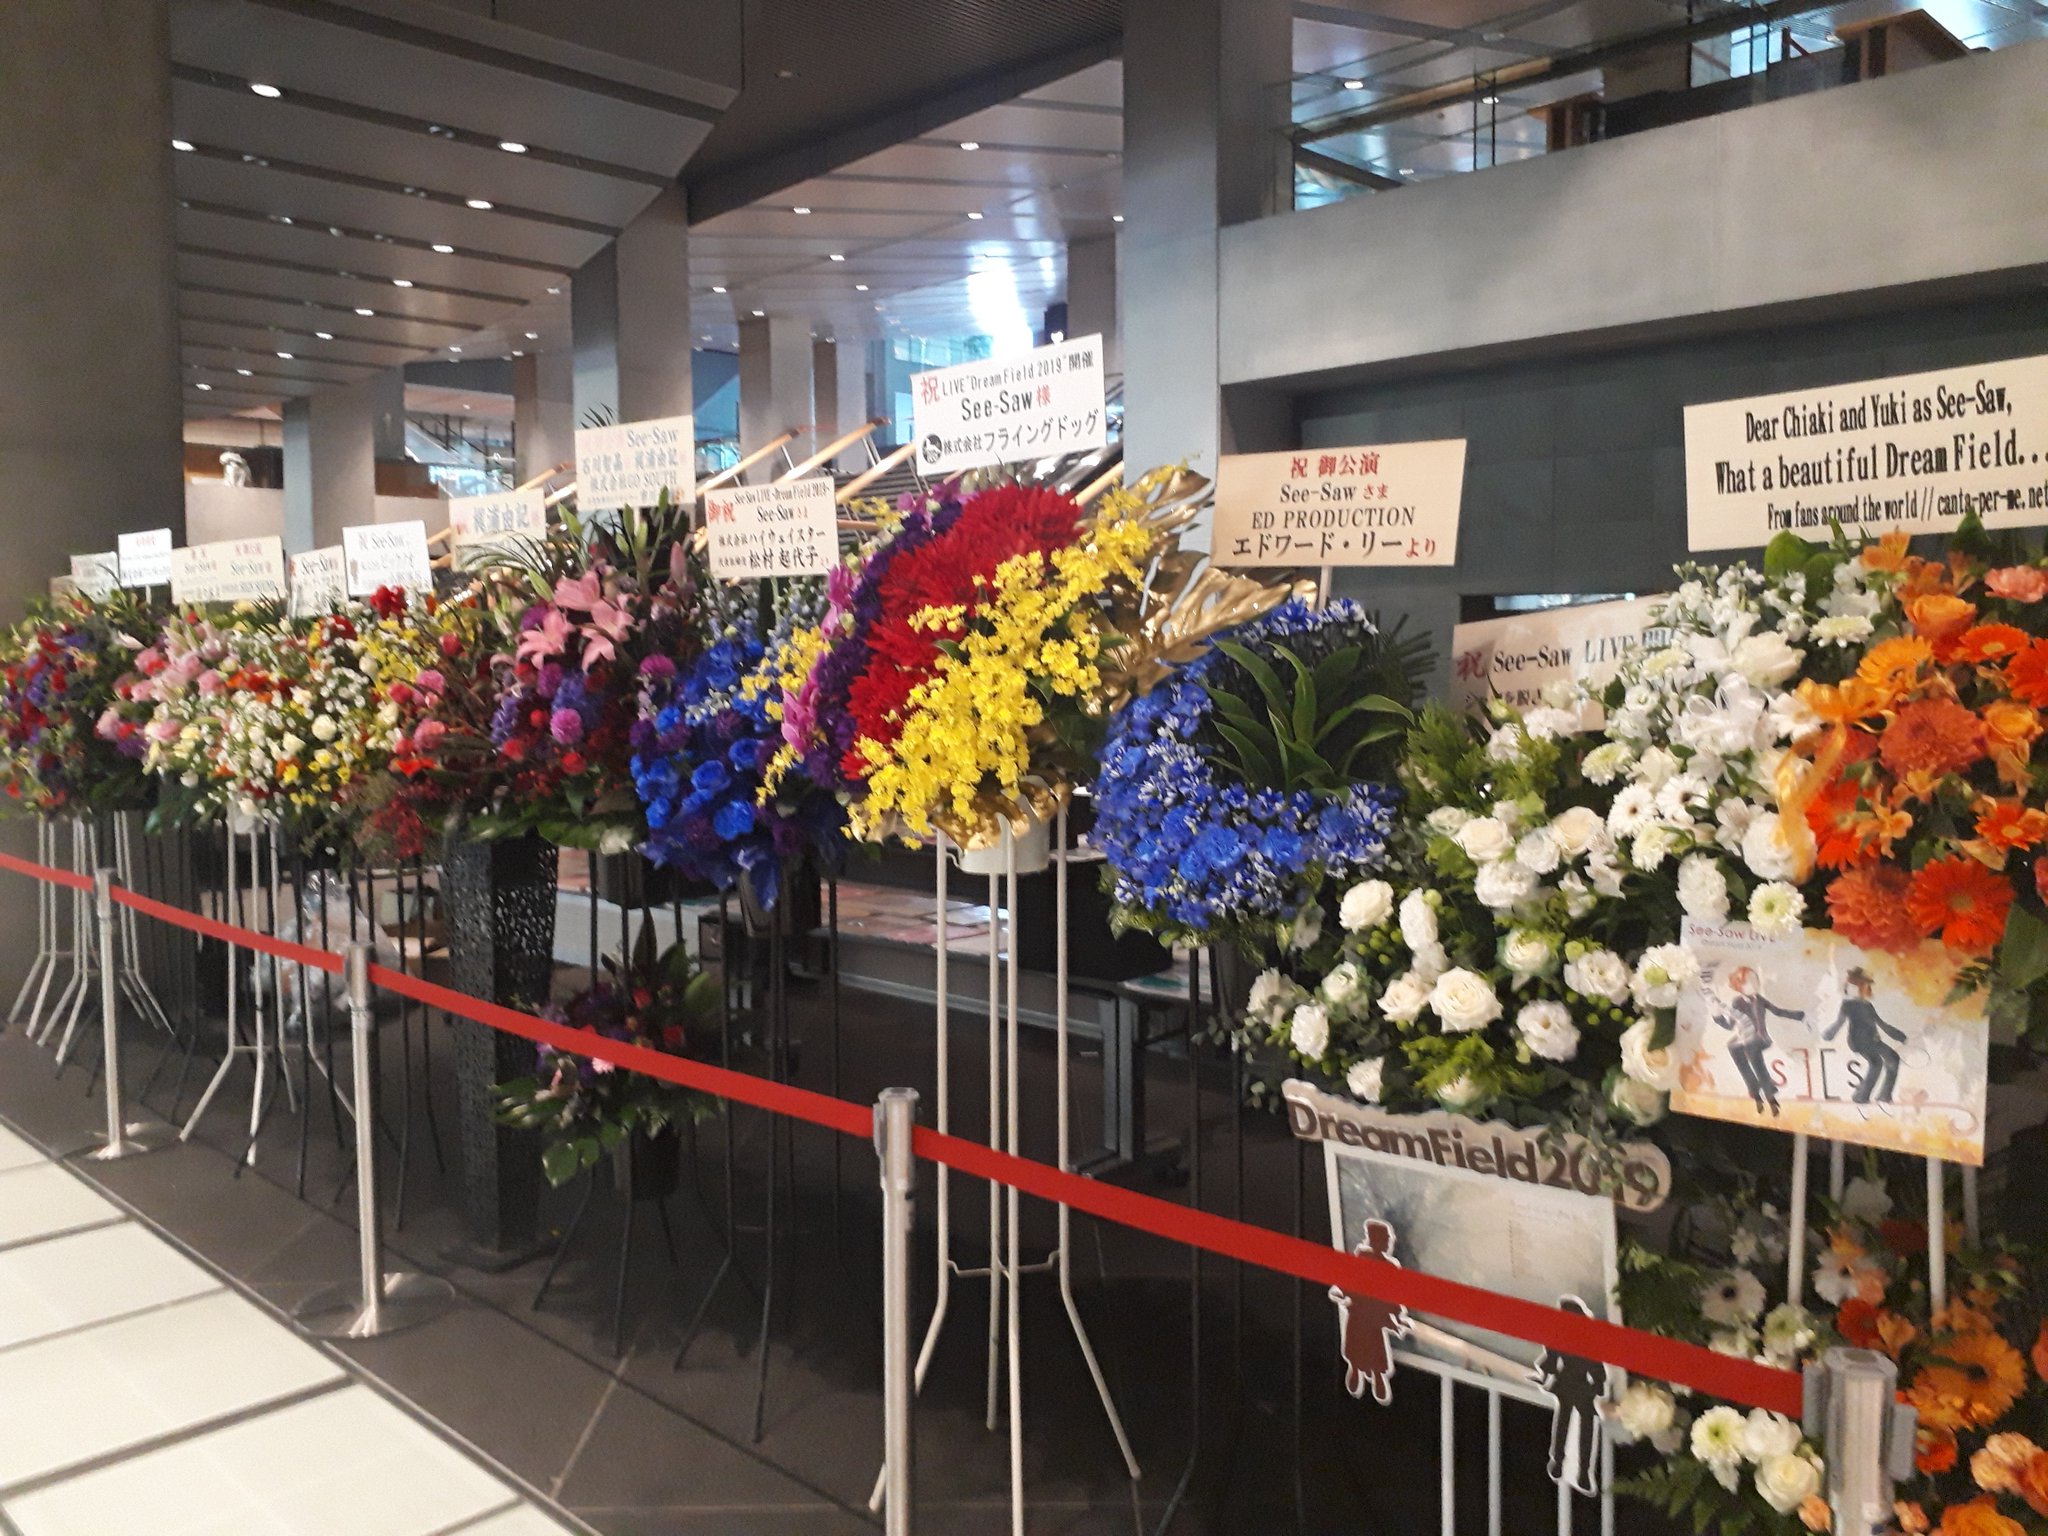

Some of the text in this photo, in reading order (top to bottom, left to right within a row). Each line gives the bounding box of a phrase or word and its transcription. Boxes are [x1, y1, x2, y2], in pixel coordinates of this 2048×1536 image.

[921, 376, 940, 406] 祝
[961, 384, 1051, 421] See-Saw 様
[1746, 379, 2012, 442] Dear Chiaki and Yuki as See-Saw,
[943, 408, 1100, 456] 株式会社フライングドッグ
[1291, 452, 1380, 479] 祝 御公演
[1714, 460, 1757, 495] What
[1762, 467, 1773, 490] a
[1778, 444, 1878, 488] beautiful
[1886, 442, 1948, 478] Dream
[1280, 482, 1389, 504] See-Saw さま
[757, 504, 794, 523] See-Saw
[1252, 506, 1416, 530] ED PRODUCTION
[1768, 502, 1792, 530] From
[1794, 500, 1819, 527] fans
[1821, 495, 1860, 526] around
[1863, 499, 1882, 521] the
[1884, 490, 1918, 520] world
[1492, 645, 1572, 673] See-Saw
